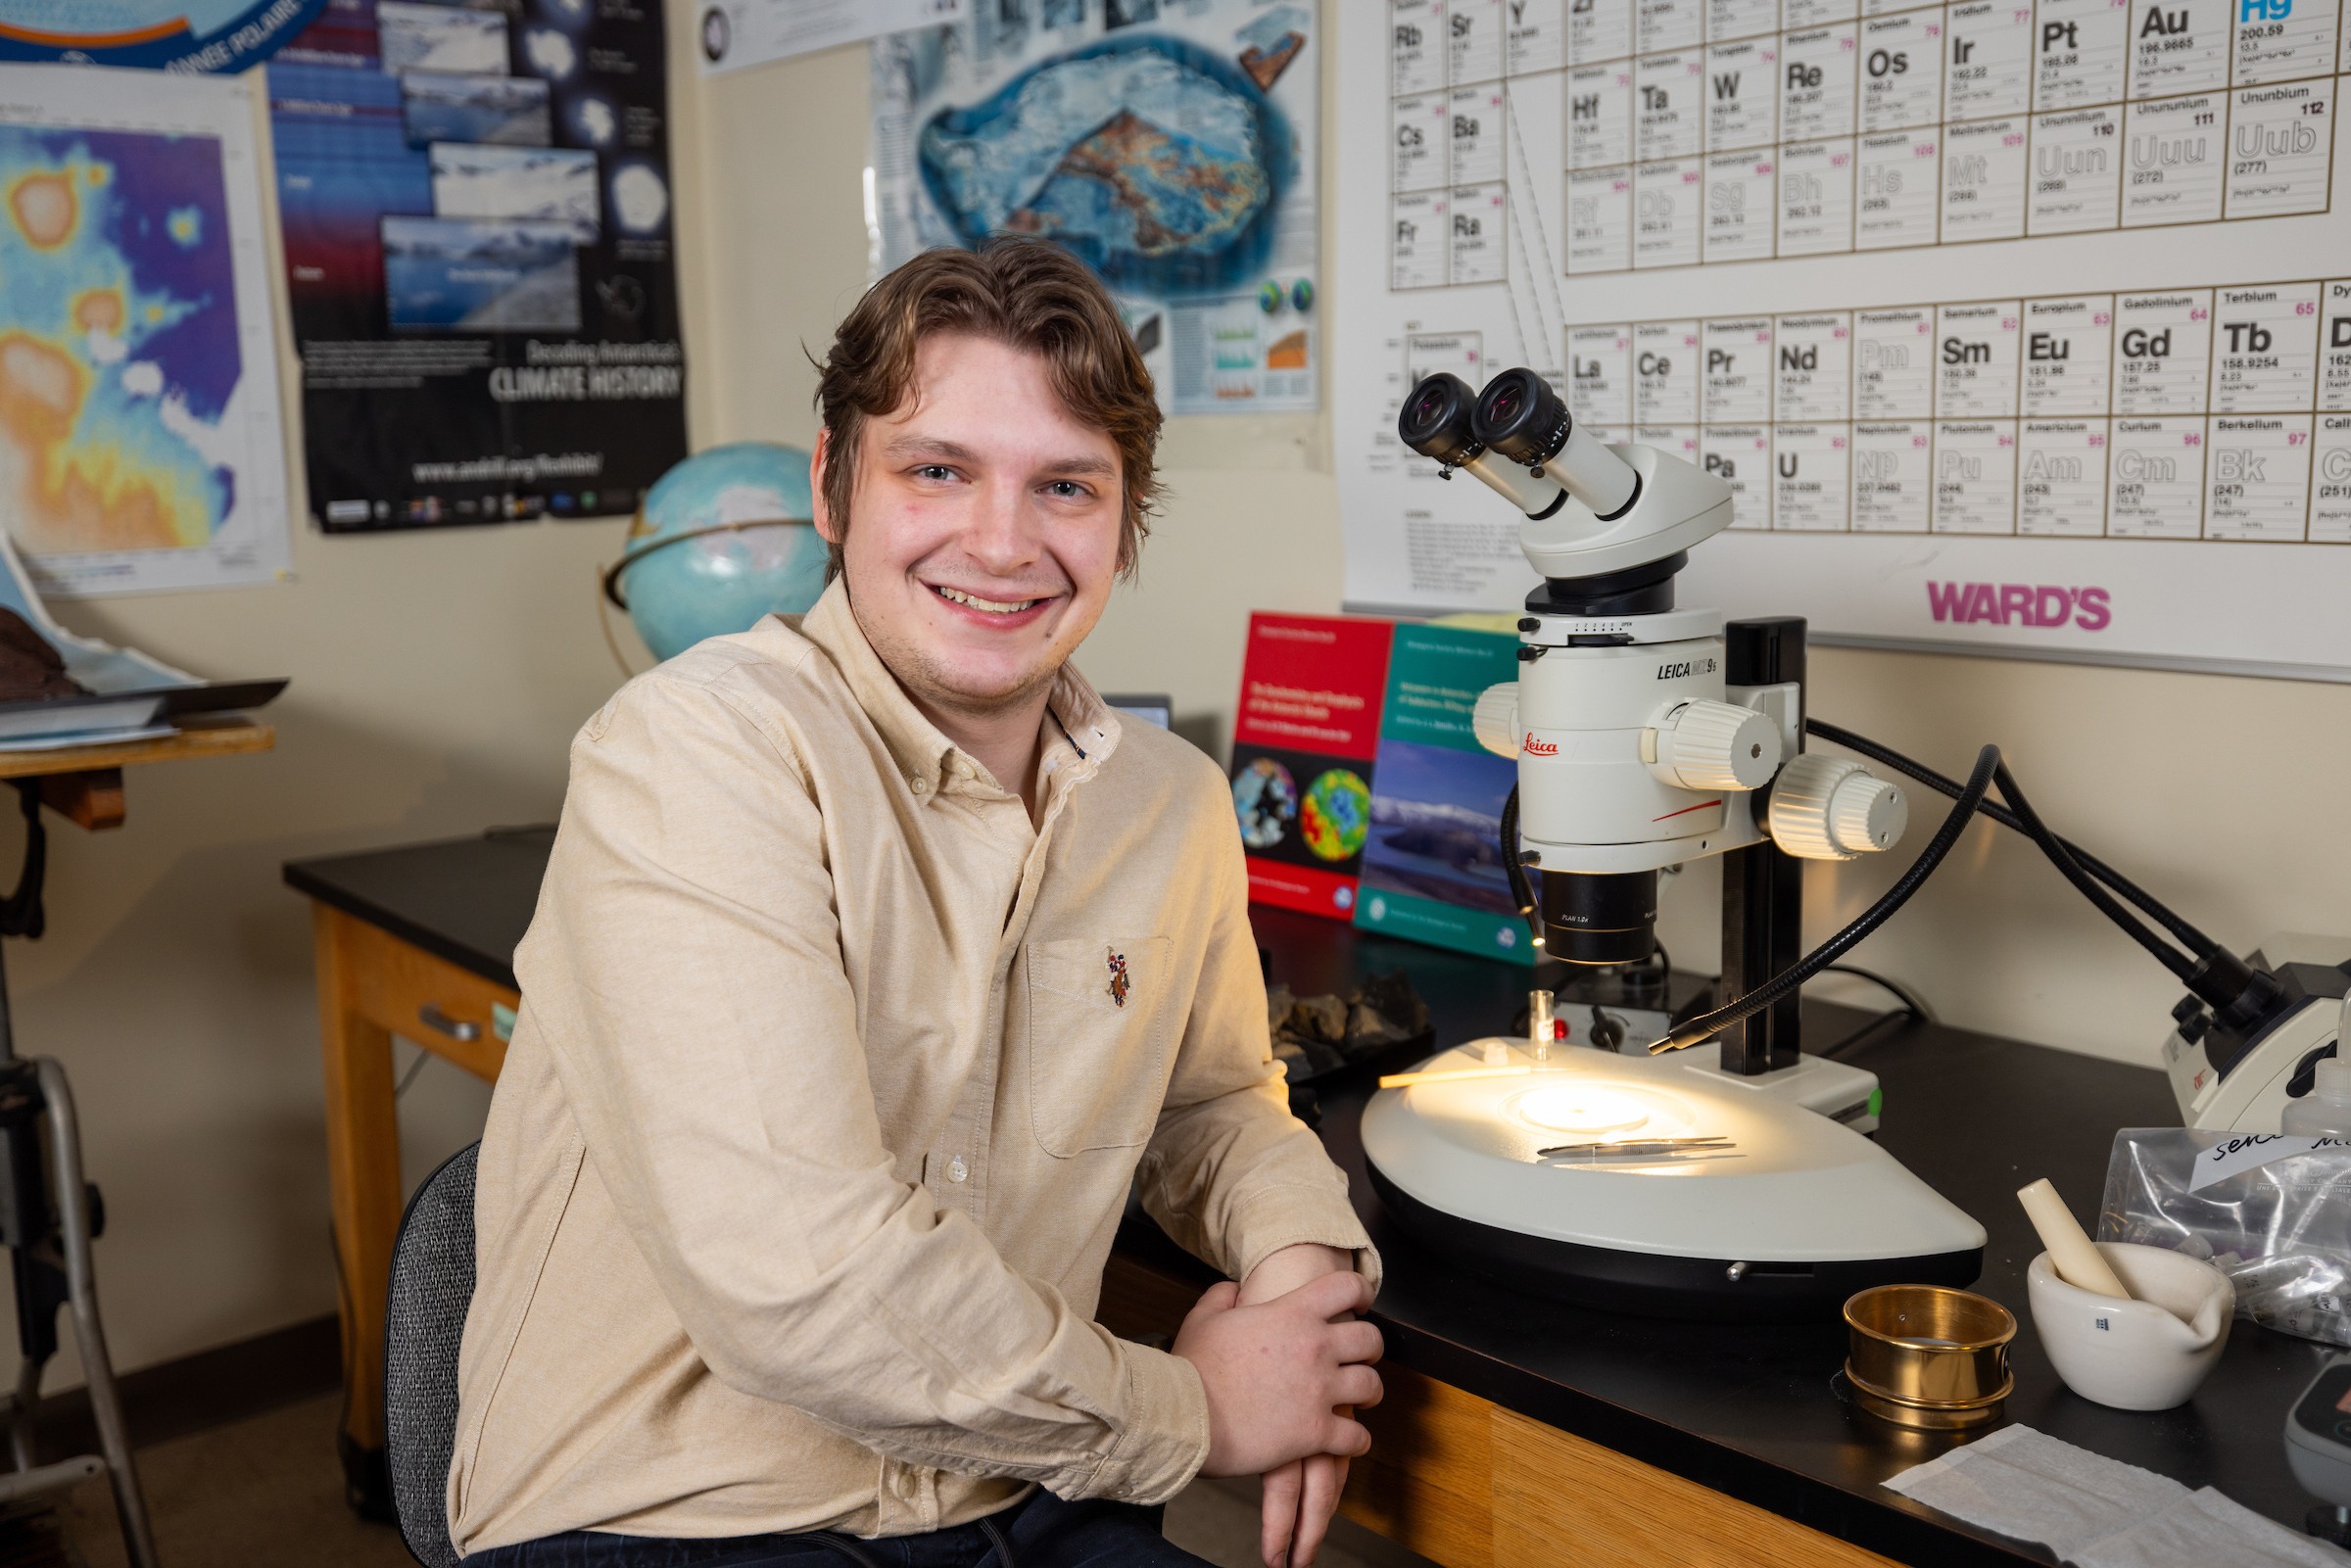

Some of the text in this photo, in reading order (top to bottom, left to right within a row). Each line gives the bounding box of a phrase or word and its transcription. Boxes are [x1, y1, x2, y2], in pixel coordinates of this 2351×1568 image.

[1953, 5, 1991, 19] Iridium
[2014, 9, 2030, 23] 77
[2140, 6, 2188, 38] Au
[2240, 0, 2292, 23] Hg
[1396, 24, 1422, 47] Rb
[1451, 13, 1473, 38] Sr
[1869, 18, 1909, 32] Osmium
[2043, 21, 2079, 51] Pt
[2240, 24, 2283, 40] 200.59
[1788, 31, 1830, 44] Rhenium
[1953, 37, 1976, 65] Ir
[1868, 49, 1907, 77] Os
[1714, 71, 1740, 100] W
[1788, 62, 1823, 90] Re
[1572, 94, 1600, 120] Hf
[1641, 84, 1668, 110] Ta
[2137, 98, 2208, 116] Unununium
[2241, 87, 2309, 104] Ununbium
[2194, 113, 2214, 126] 111
[2301, 102, 2324, 115] 112
[1398, 122, 1423, 147] Cs
[1453, 114, 1480, 138] Ba
[2093, 123, 2114, 137] 110
[2237, 119, 2316, 159] Uub
[2039, 146, 2106, 178] Uun
[2133, 136, 2206, 169] Uuu
[1948, 155, 1988, 186] Mt
[2134, 170, 2163, 184] (272)
[2234, 160, 2267, 175] (277)
[1785, 172, 1822, 203] Bh
[1863, 166, 1902, 195] Hs
[1639, 190, 1675, 217] Db
[1711, 182, 1746, 211] Sg
[1397, 219, 1418, 242] Fr
[1454, 214, 1481, 237] Ra
[2032, 302, 2086, 314] Europium
[2125, 296, 2192, 309] Gadolinium
[2226, 291, 2277, 303] Terbium
[1861, 312, 1922, 323] Promethium
[1945, 308, 1996, 319] Samarium
[2093, 312, 2110, 326] 63
[2189, 309, 2208, 322] 64
[2296, 303, 2315, 315] 65
[1782, 318, 1837, 330] Neodymium
[2030, 332, 2069, 360] Eu
[2123, 327, 2172, 358] Gd
[2224, 322, 2272, 353] Tb
[1708, 349, 1735, 373] Pr
[1781, 344, 1817, 370] Nd
[1859, 340, 1909, 369] Pm
[1943, 337, 1991, 364] Sm
[1575, 355, 1601, 378] La
[1639, 352, 1671, 376] Ce
[2122, 362, 2161, 373] 157.25
[2223, 357, 2279, 369] 158.9254
[489, 365, 682, 402] CLIMATE HISTORY
[1858, 425, 1910, 435] Neptunium
[1942, 423, 1994, 434] Plutonium
[2027, 422, 2087, 433] Americium
[2119, 421, 2161, 432] Curium
[2218, 419, 2282, 431] Berkelium
[2088, 434, 2105, 447] 95
[2183, 433, 2201, 447] 96
[2288, 433, 2307, 446] 97
[1705, 453, 1735, 478] Pa
[1779, 453, 1798, 478] U
[1857, 451, 1898, 481] Np
[1940, 450, 1982, 481] Pu
[2024, 450, 2083, 482] Am
[2117, 449, 2177, 482] Cm
[2216, 449, 2267, 482] Bk
[2117, 485, 2144, 496] (247)
[2215, 485, 2243, 498] (247)
[1928, 581, 2111, 631] WARD'S
[1657, 662, 1690, 680] LEICA
[1523, 733, 1559, 756] Leica
